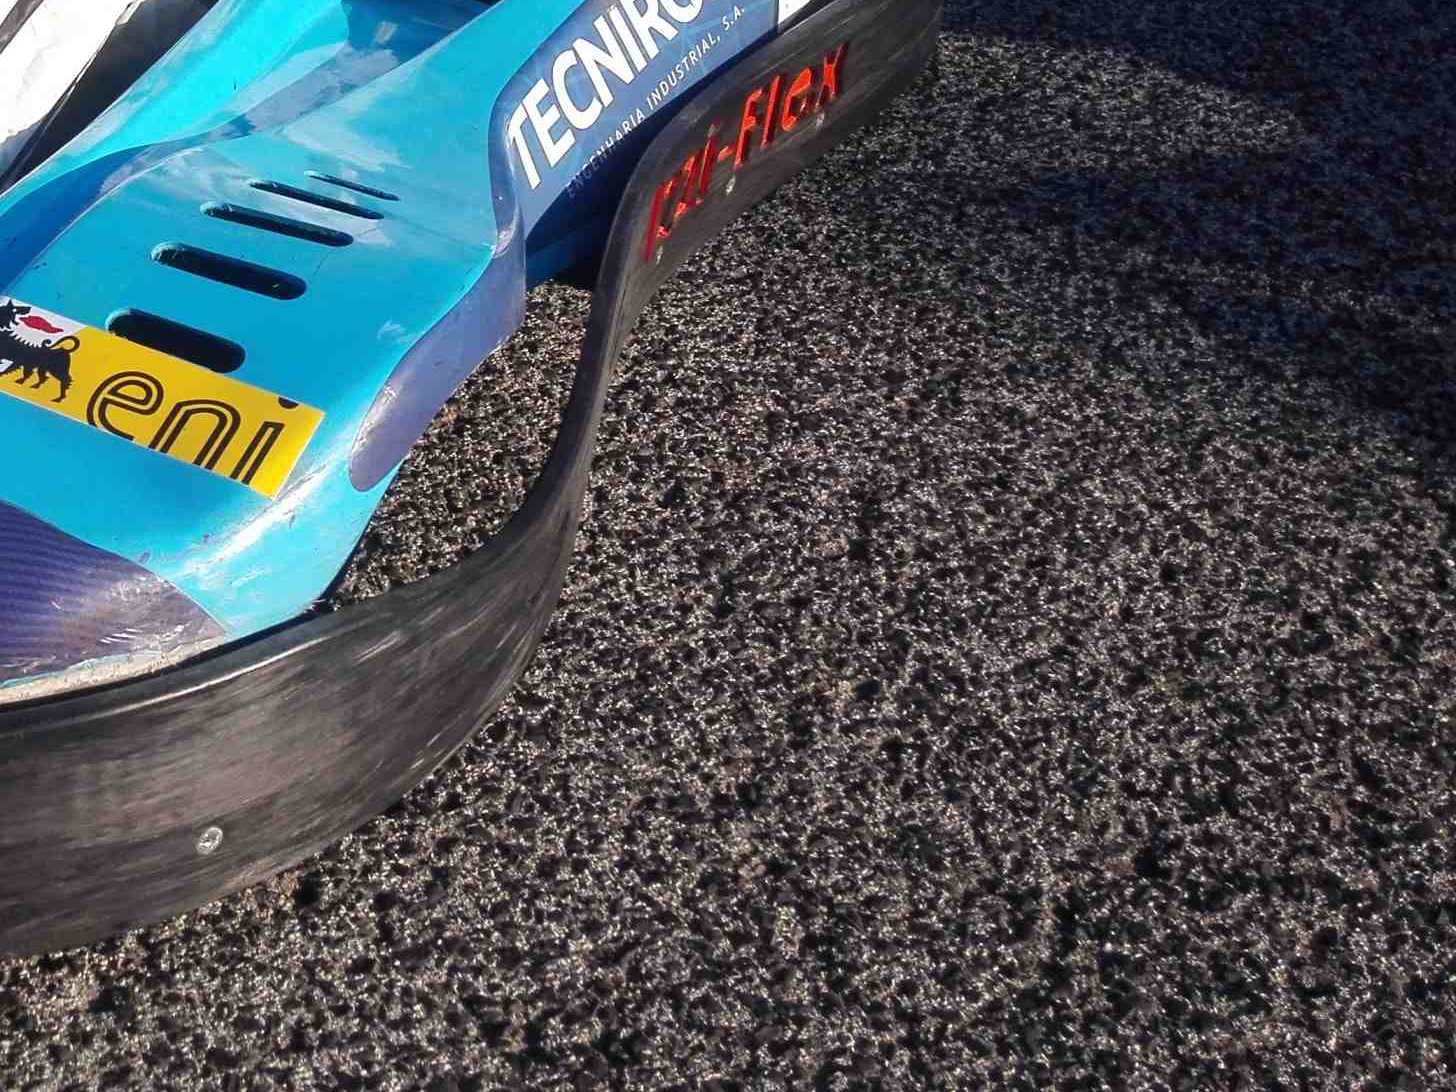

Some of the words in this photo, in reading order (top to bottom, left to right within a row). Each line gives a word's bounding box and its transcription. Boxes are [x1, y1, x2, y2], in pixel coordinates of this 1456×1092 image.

[646, 34, 721, 110] INDUSTRIAL,
[722, 4, 745, 31] S.A.
[87, 371, 299, 484] eni
